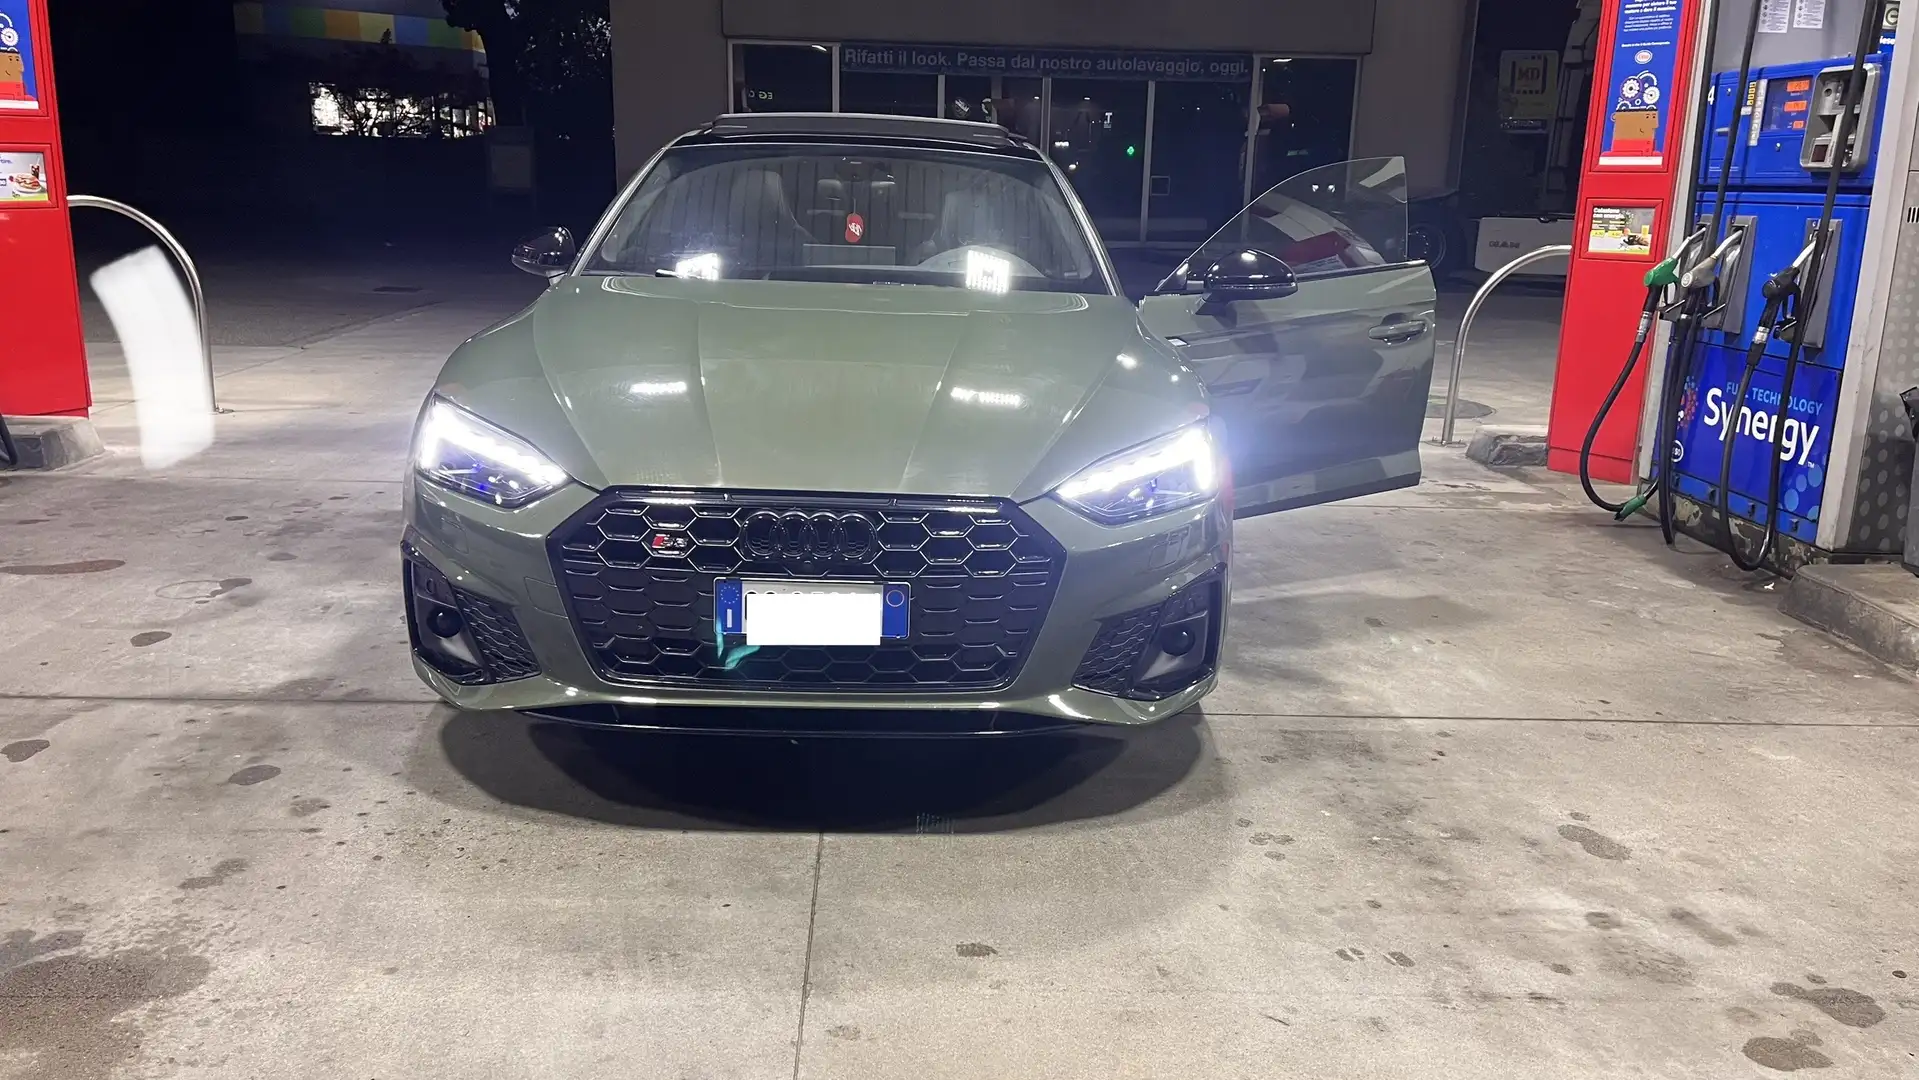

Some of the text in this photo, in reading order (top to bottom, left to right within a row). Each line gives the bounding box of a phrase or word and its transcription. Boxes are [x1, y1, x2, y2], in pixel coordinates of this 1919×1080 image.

[845, 49, 1249, 75] Rifatti il look. Passa dal nostro autolavaggio, oggi.
[1707, 85, 1715, 105] 4
[1726, 381, 1749, 399] FU
[1704, 387, 1820, 466] Synergy
